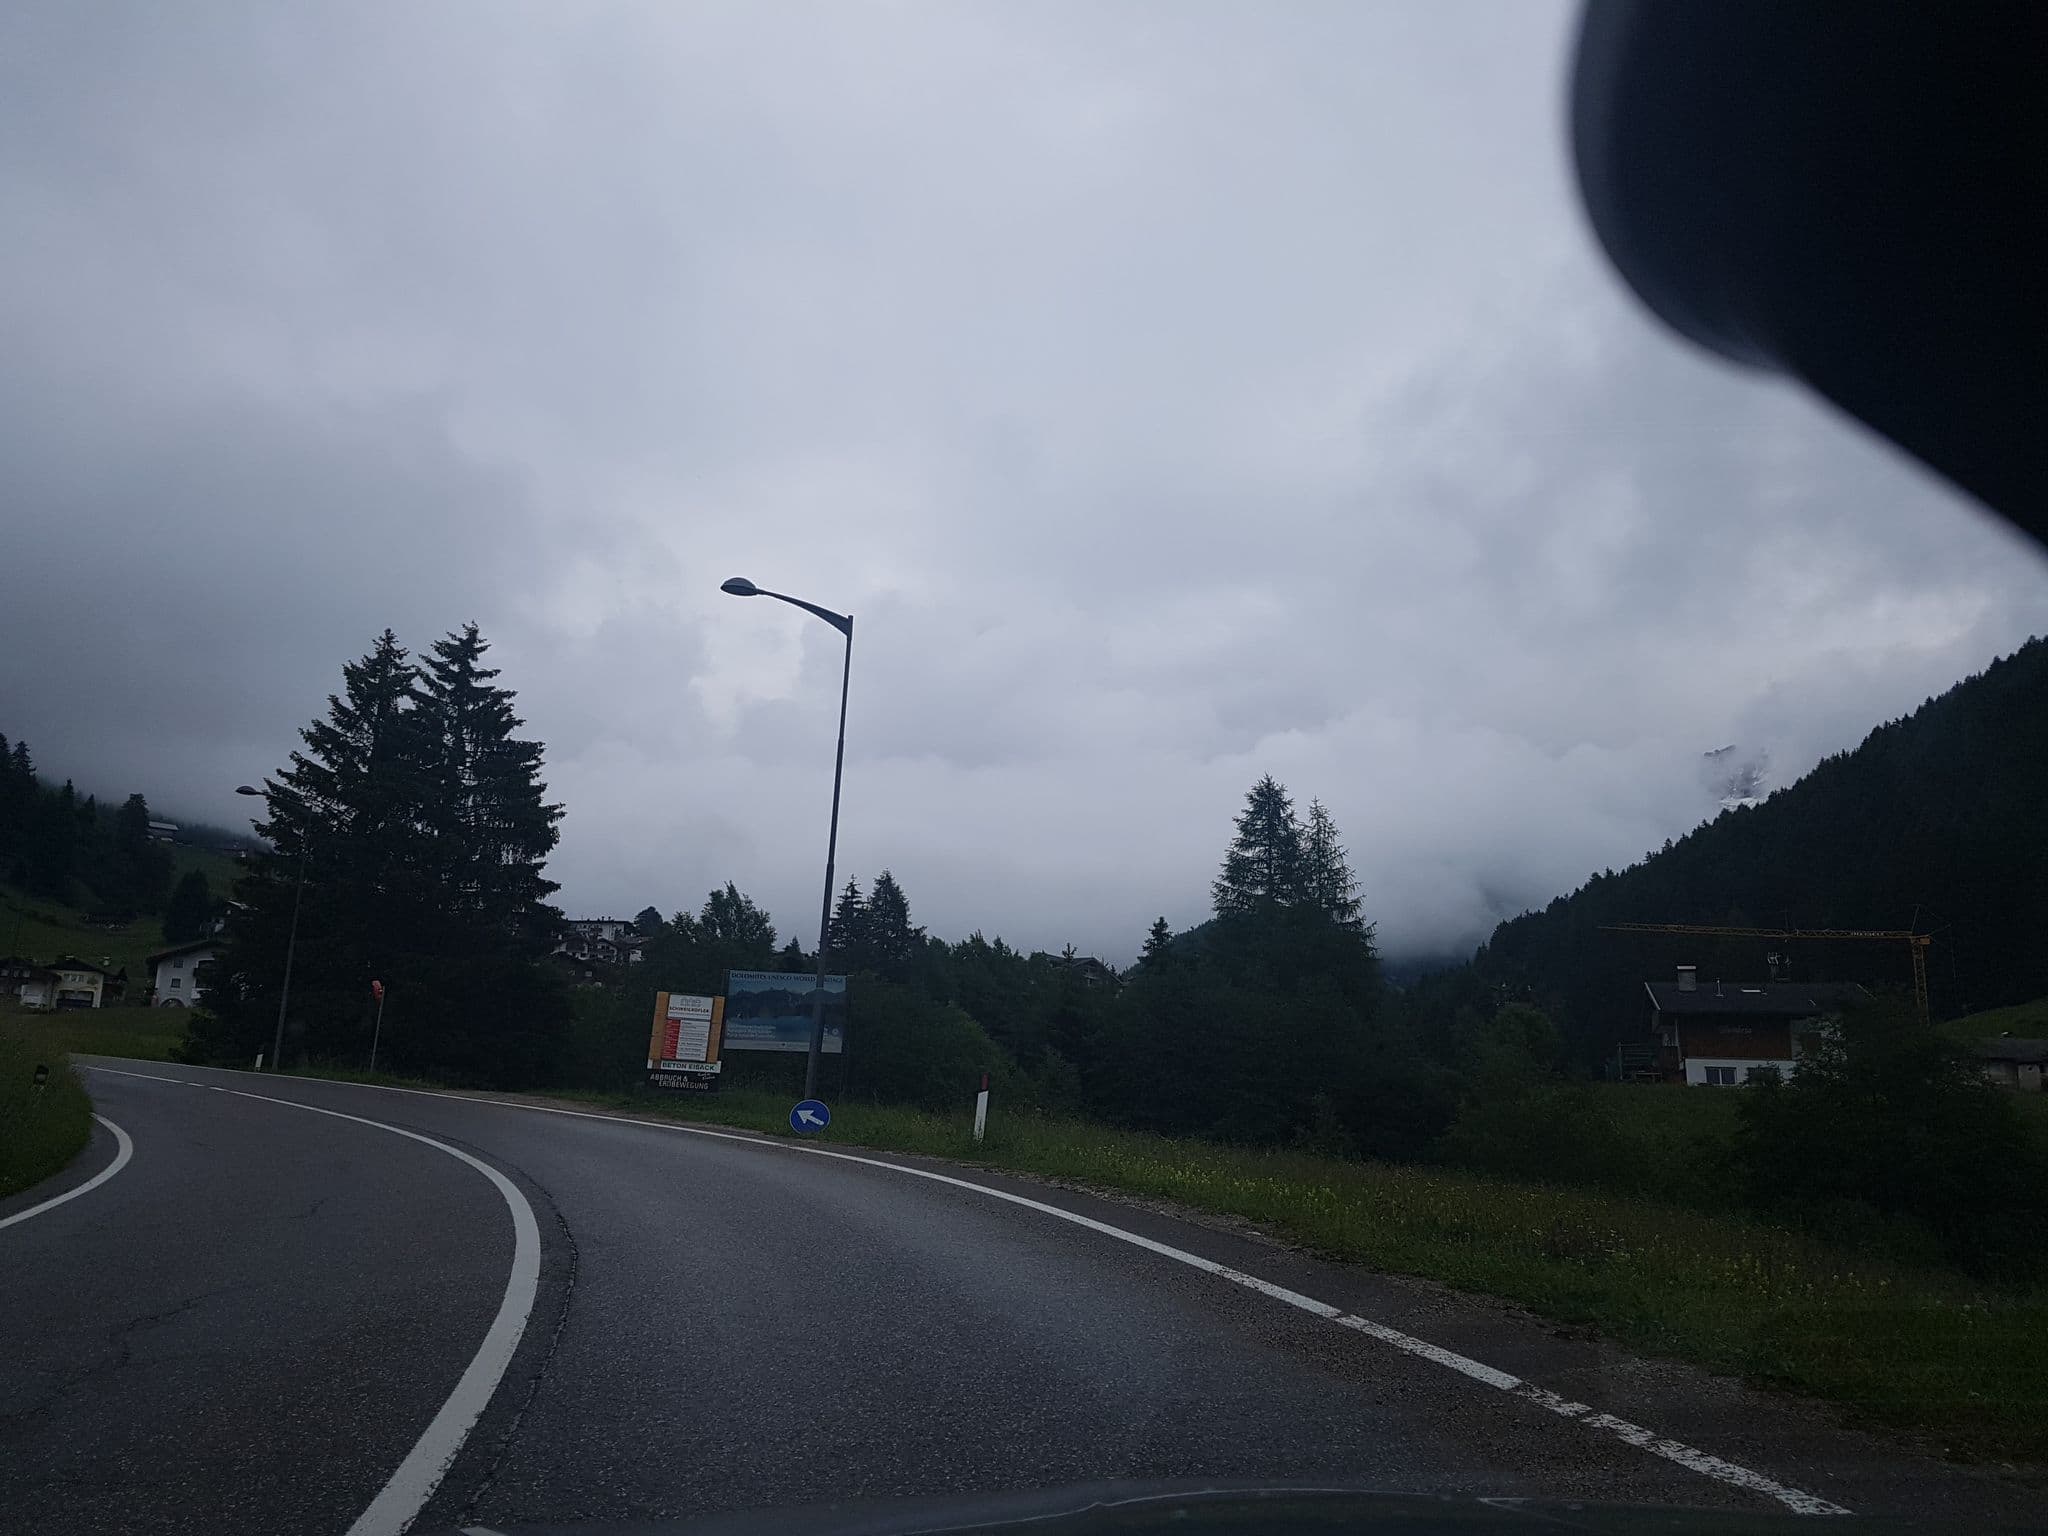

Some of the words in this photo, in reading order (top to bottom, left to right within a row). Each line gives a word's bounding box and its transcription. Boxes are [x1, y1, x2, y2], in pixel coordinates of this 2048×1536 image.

[688, 1063, 715, 1071] EISACK
[650, 1073, 682, 1082] ABBRUCH
[658, 1081, 709, 1090] ERDBEWEGUNG
